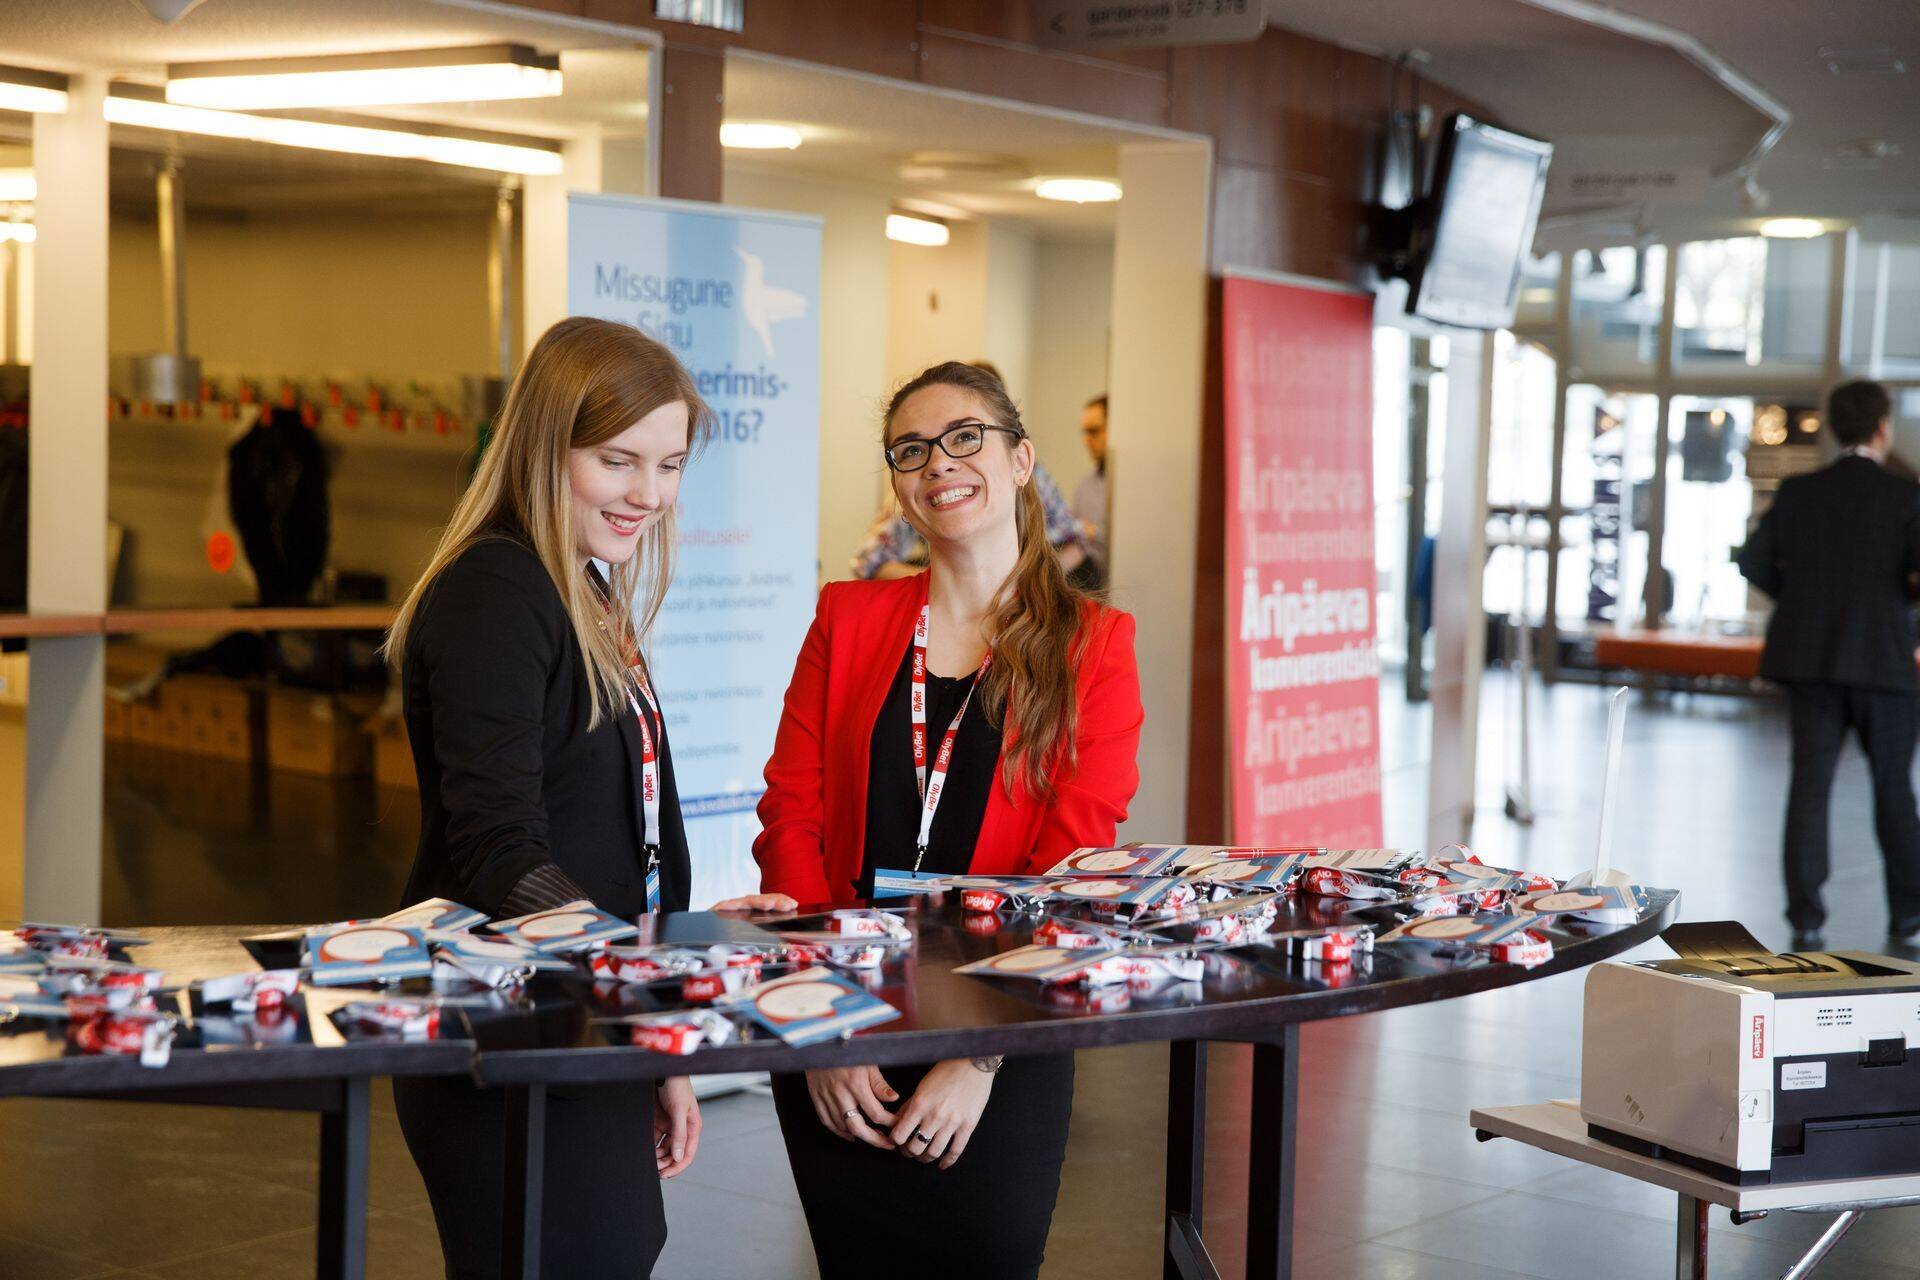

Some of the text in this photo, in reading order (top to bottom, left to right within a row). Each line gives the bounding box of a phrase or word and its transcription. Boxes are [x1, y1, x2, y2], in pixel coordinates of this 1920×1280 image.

[594, 264, 733, 315] Missugune
[637, 310, 693, 348] Sinu
[1239, 440, 1364, 525] Äripäeva
[1240, 566, 1369, 652] Äripäeva
[914, 653, 923, 676] OlyBet
[913, 690, 922, 713] OlyBet
[914, 730, 923, 759] OlyBet
[1244, 692, 1371, 774] Äripäeva
[938, 737, 953, 765] OlyBet
[644, 773, 654, 802] OlyBet
[927, 783, 941, 811] OlyBet
[965, 893, 996, 908] OlyBet
